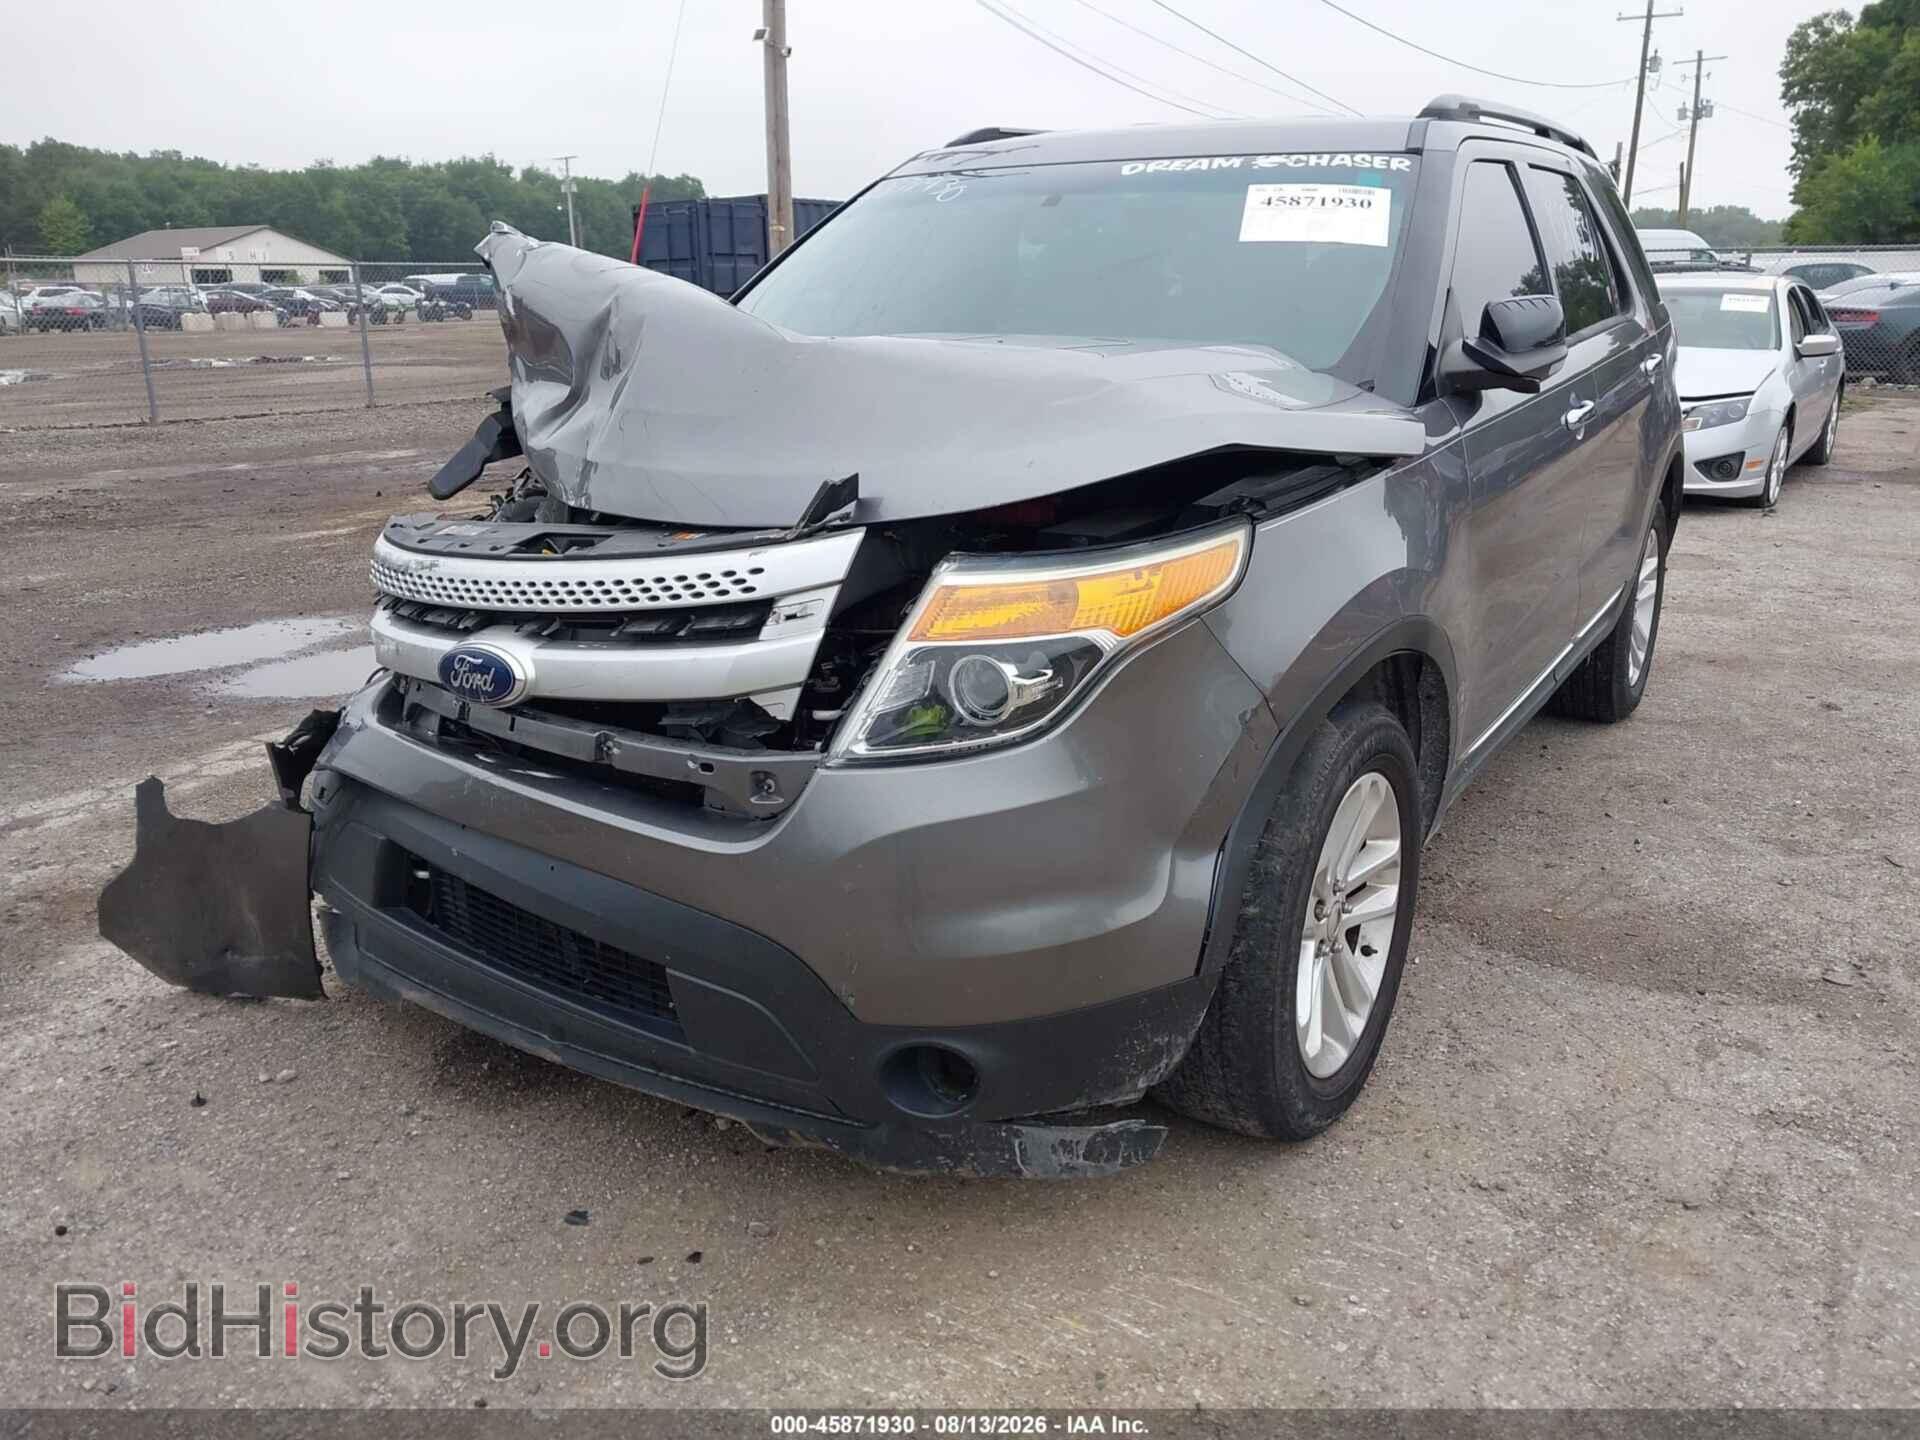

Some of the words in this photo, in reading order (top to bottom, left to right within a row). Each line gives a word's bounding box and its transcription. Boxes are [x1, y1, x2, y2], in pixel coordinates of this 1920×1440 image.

[1121, 157, 1242, 175] DREAM
[1286, 153, 1412, 172] CHASER
[1261, 195, 1373, 209] 45871930
[451, 654, 496, 692] Ford
